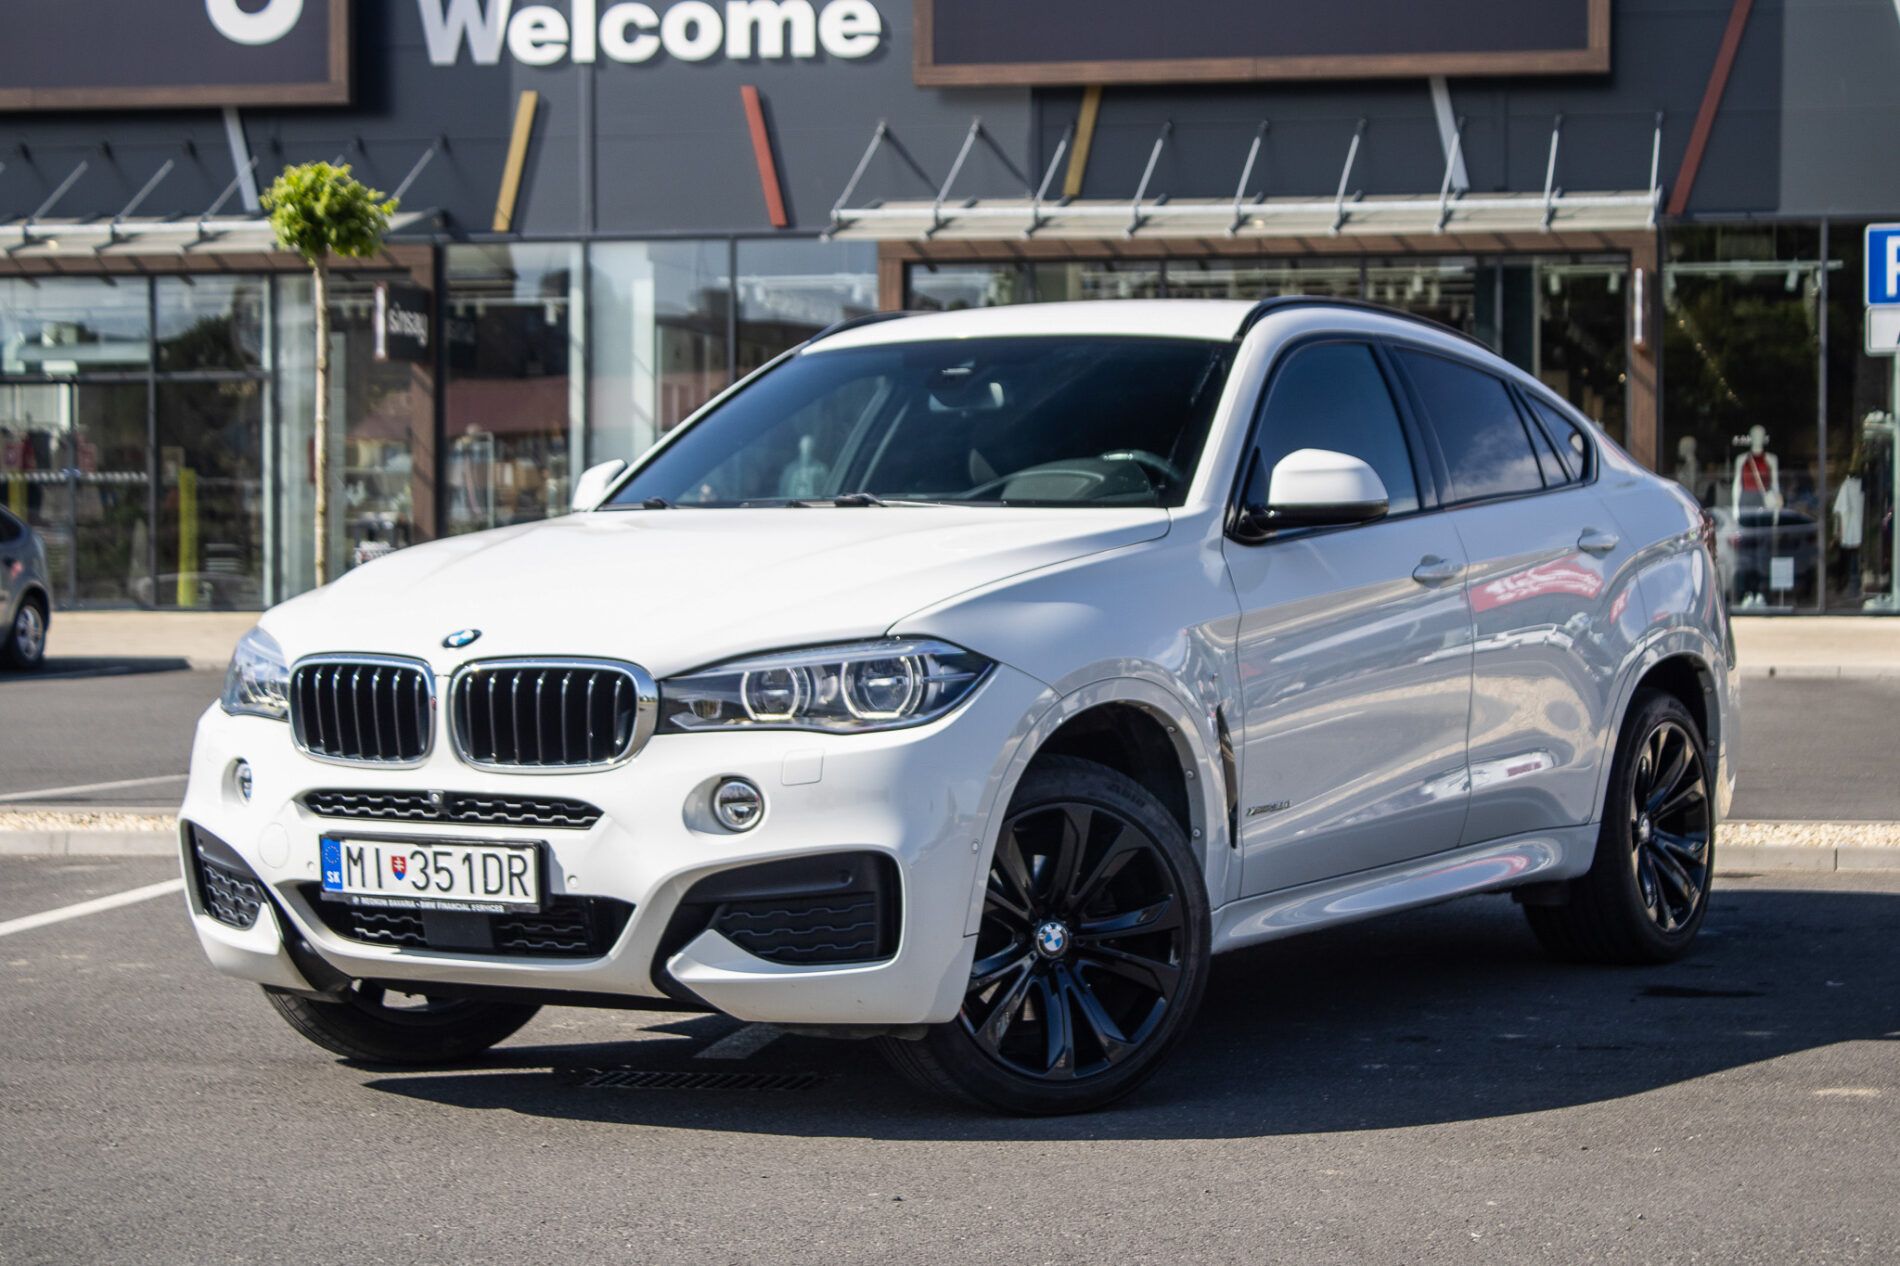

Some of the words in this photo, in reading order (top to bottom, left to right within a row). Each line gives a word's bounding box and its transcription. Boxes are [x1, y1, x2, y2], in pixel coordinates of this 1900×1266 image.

[417, 0, 881, 65] Welcome
[327, 870, 341, 884] SK
[346, 846, 382, 888] MI
[410, 850, 529, 896] 351DR
